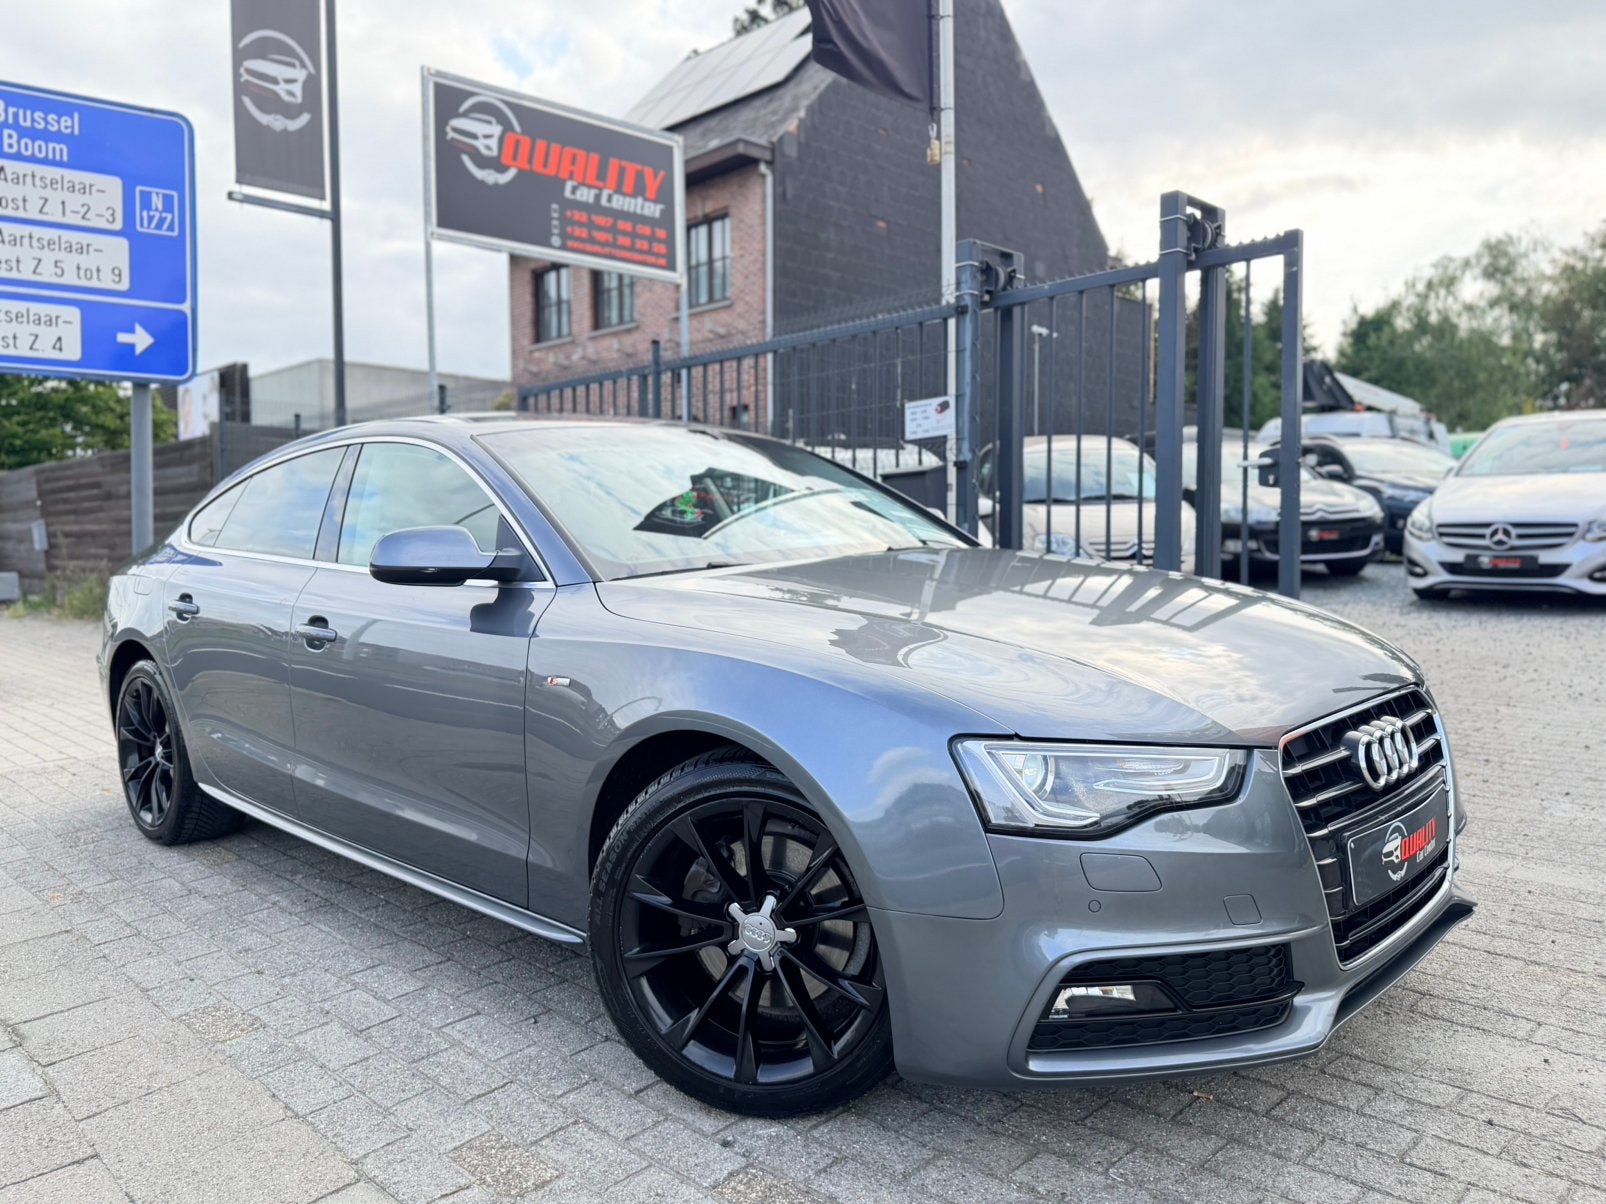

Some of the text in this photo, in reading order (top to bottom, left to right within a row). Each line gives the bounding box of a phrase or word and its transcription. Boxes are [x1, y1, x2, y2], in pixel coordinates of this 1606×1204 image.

[2, 128, 68, 162] Boom
[500, 130, 666, 200] QUALITY
[152, 191, 163, 211] N
[563, 180, 666, 219] Car Center
[61, 200, 116, 224] 1-2-3
[142, 210, 173, 231] 177
[76, 263, 102, 283] tot
[111, 266, 122, 285] 9
[0, 307, 73, 328] selaar-
[52, 336, 63, 353] 4
[1401, 817, 1437, 862] QUALITY
[597, 830, 629, 895] SEASON
